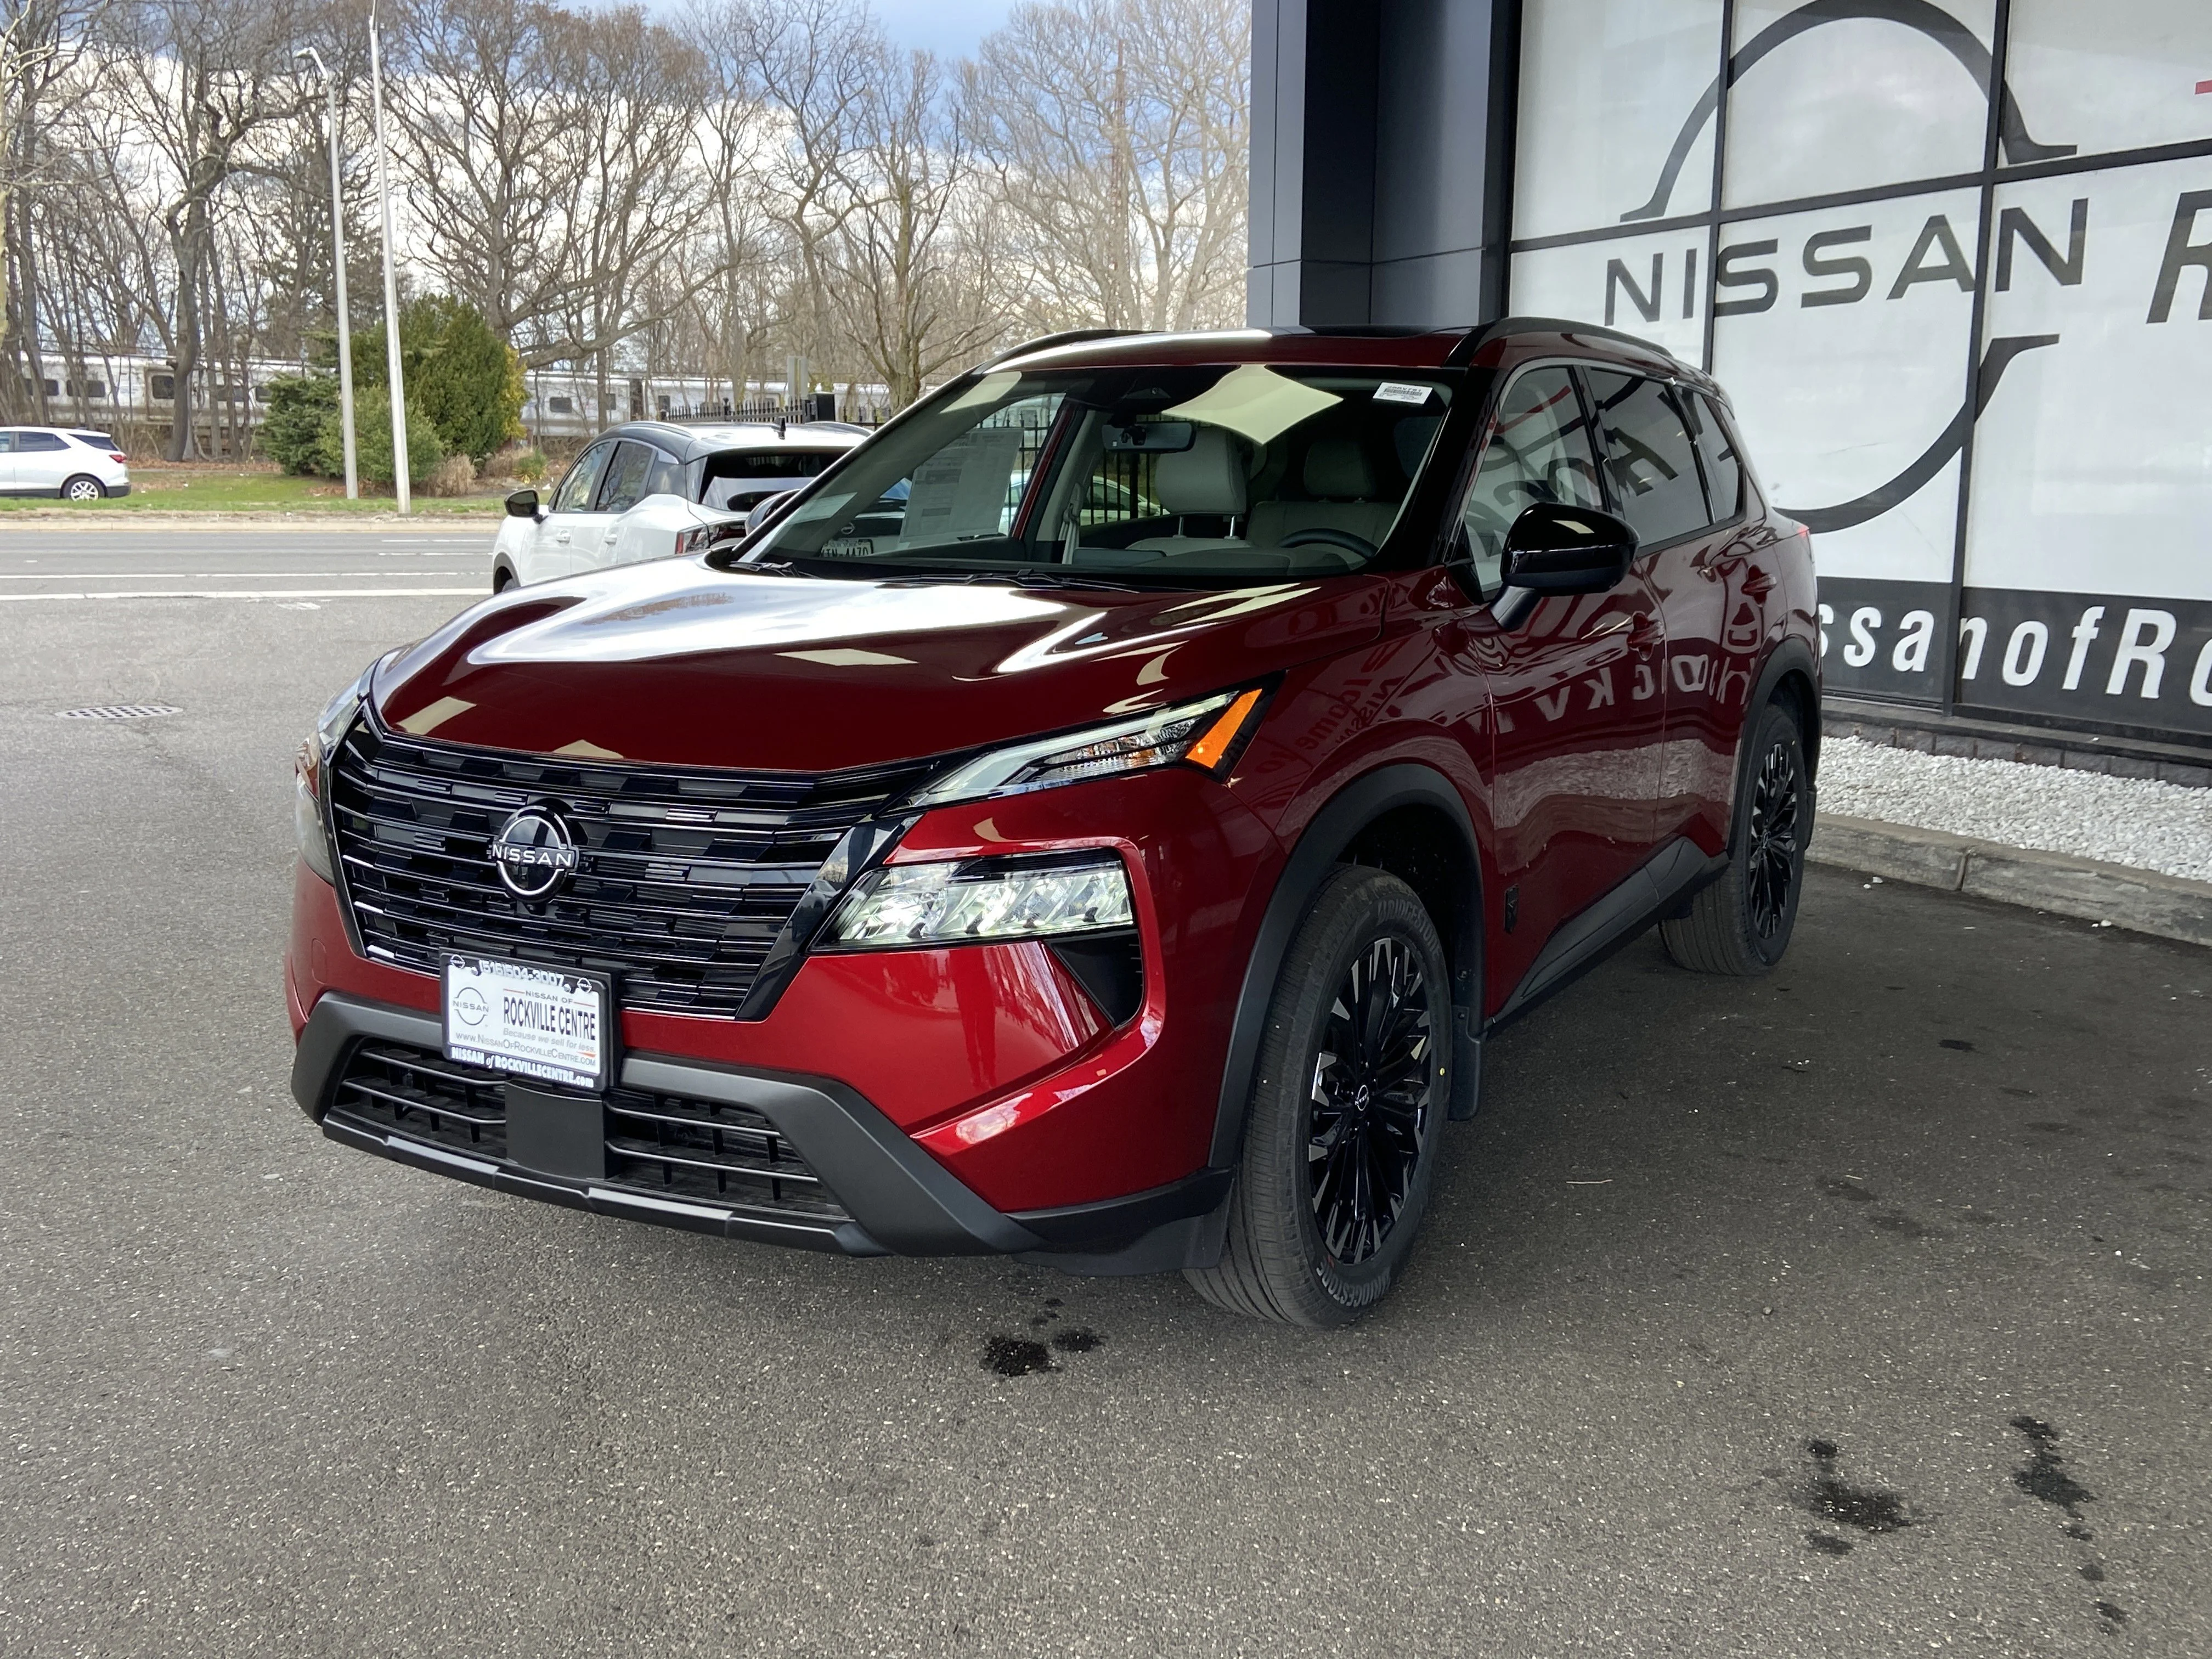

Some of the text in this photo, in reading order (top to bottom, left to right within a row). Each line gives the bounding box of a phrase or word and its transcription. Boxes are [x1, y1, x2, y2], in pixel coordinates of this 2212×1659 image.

[1604, 198, 2089, 327] NISSAN
[492, 844, 572, 866] NISSAN
[453, 1000, 489, 1013] NISSAN
[525, 990, 558, 1002] NISSAN
[503, 996, 596, 1041] ROCKVILLE CENTRE
[503, 1028, 536, 1041] Because
[538, 1036, 549, 1044] we
[551, 1036, 565, 1047] sell
[566, 1039, 577, 1050] for
[451, 1046, 595, 1088] NISSAN of ROCKVILLECENTRE.com
